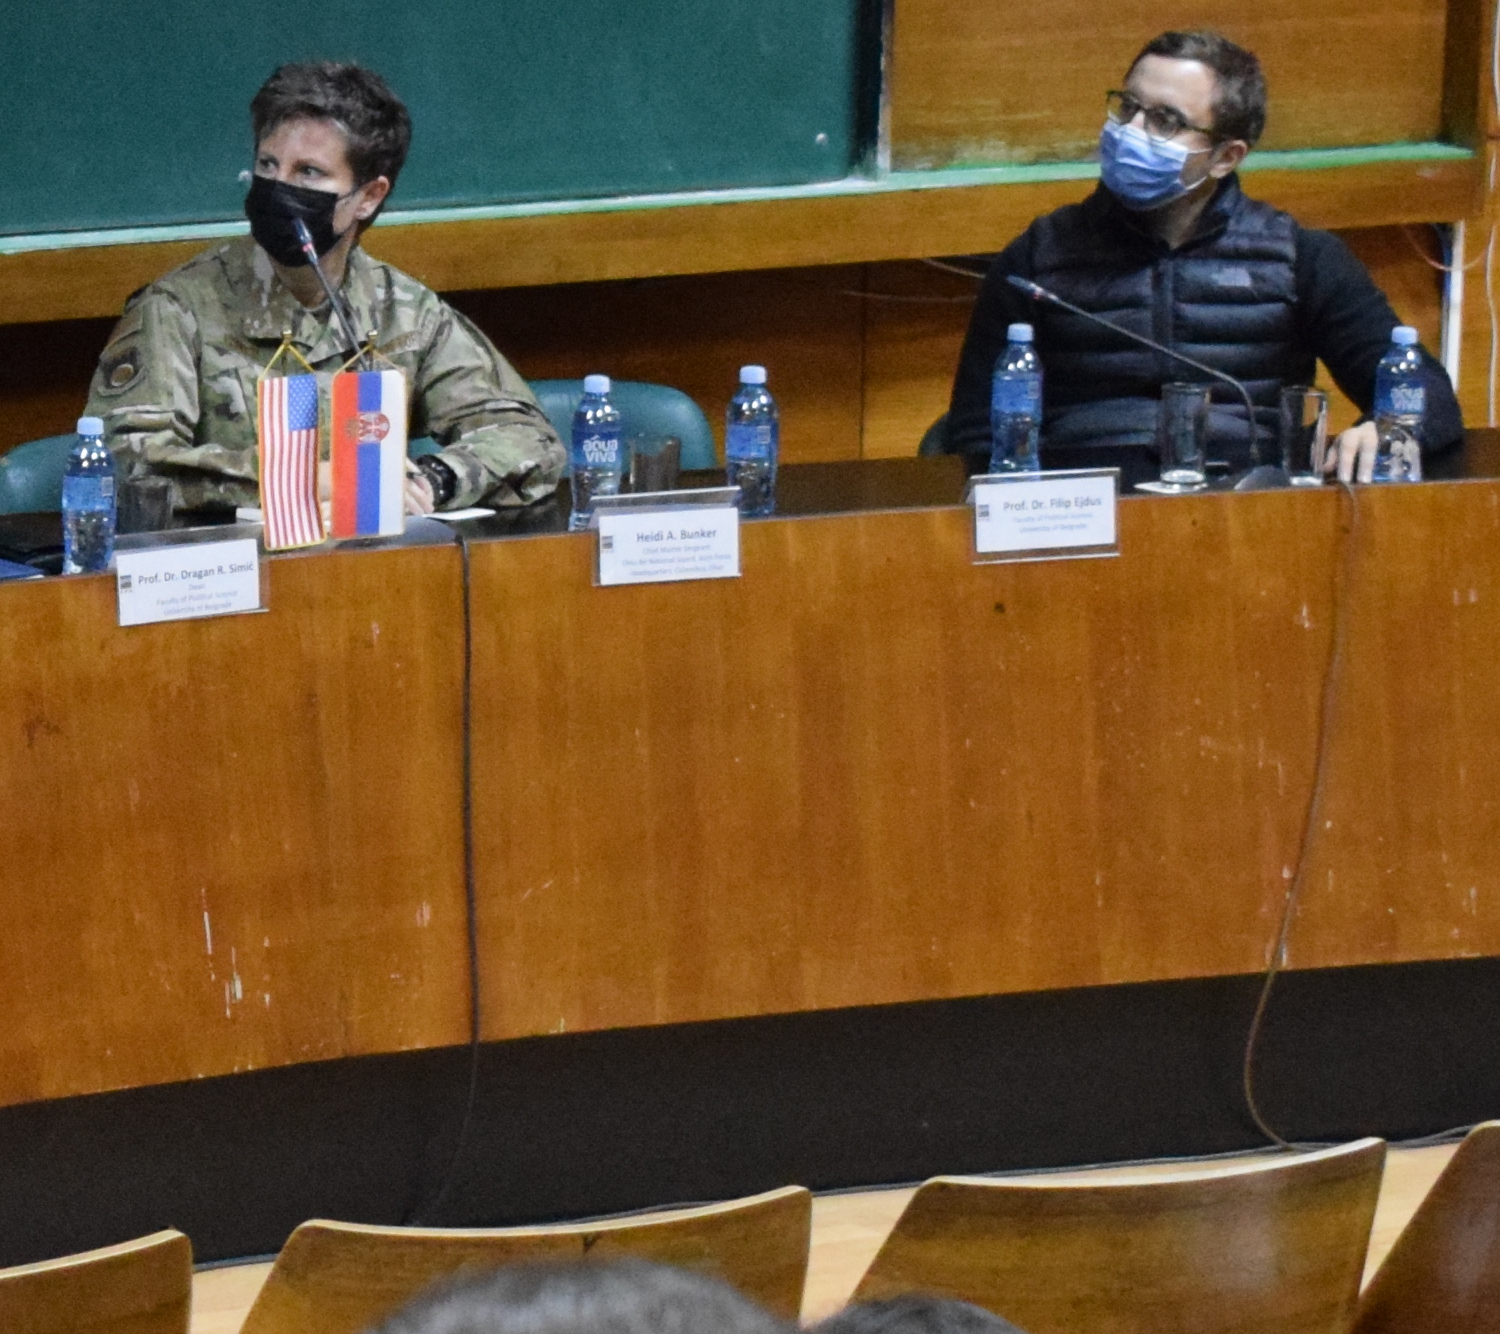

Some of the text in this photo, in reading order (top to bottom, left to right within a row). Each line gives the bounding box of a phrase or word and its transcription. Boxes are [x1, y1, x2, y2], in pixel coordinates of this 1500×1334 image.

[1003, 496, 1102, 511] Prof. Dr. Filip Ejdus
[636, 529, 717, 542] Heidi A. Bunker
[138, 562, 254, 585] Prof. Dr. Dragan R. Simić
